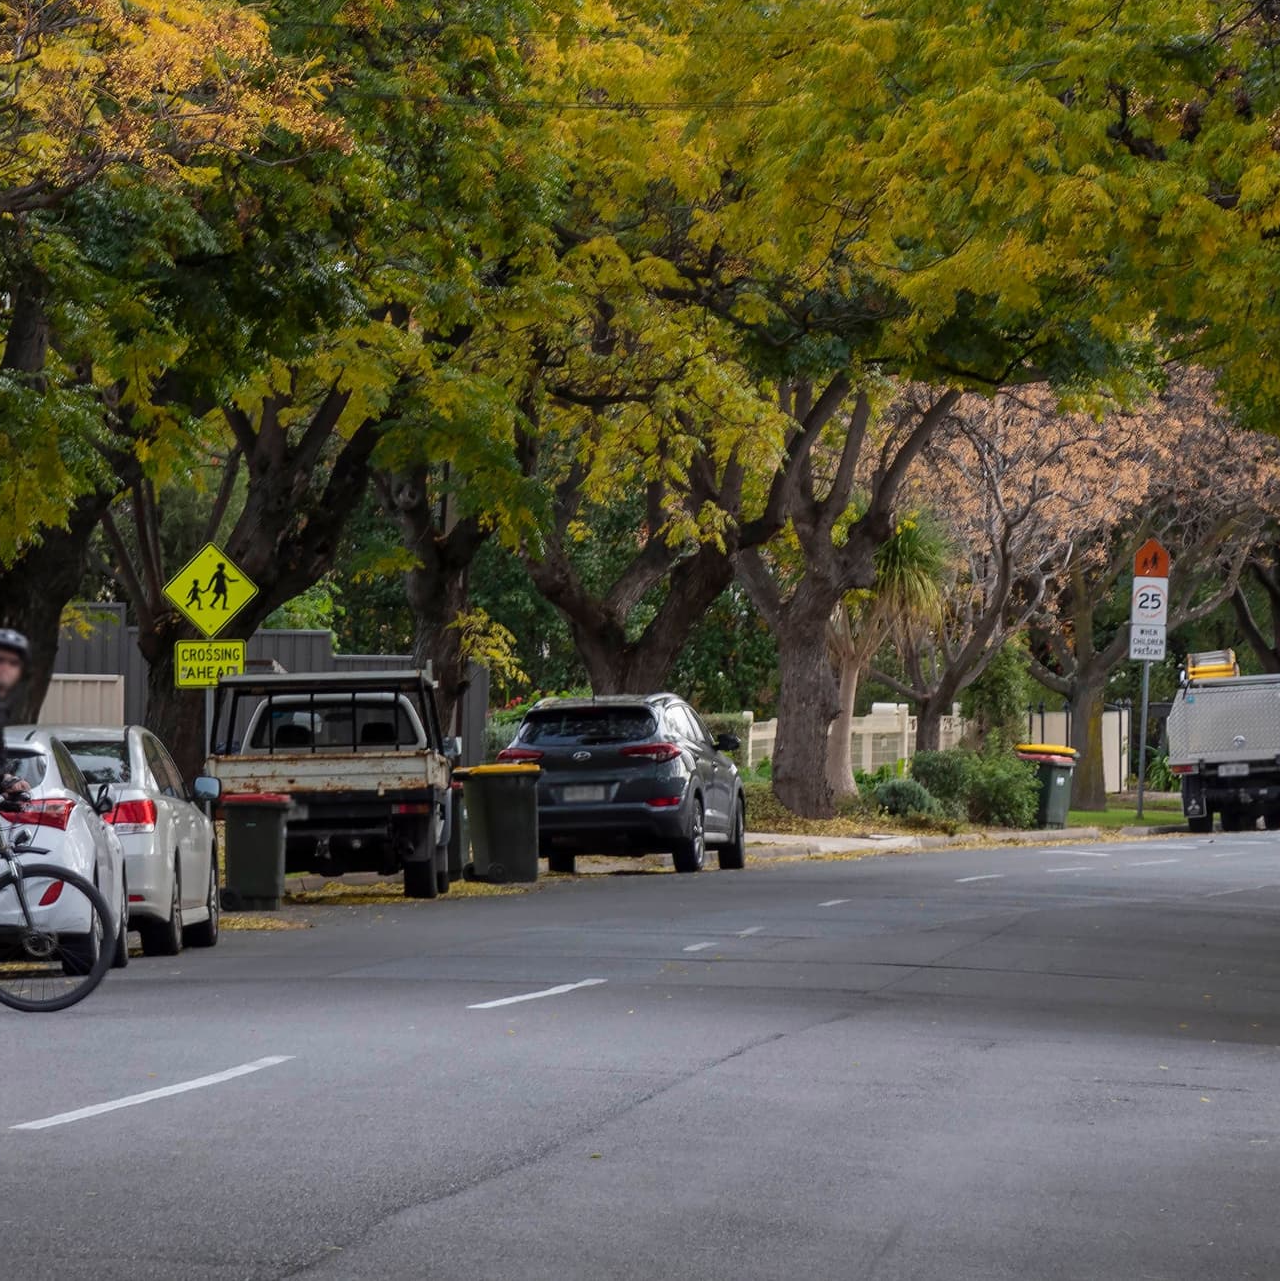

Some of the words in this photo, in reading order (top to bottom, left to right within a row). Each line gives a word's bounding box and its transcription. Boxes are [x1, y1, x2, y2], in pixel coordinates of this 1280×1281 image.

[1138, 592, 1162, 610] 25
[1132, 637, 1164, 646] CHILDREN
[181, 648, 240, 662] CROSSING
[1133, 647, 1162, 655] PRESENT
